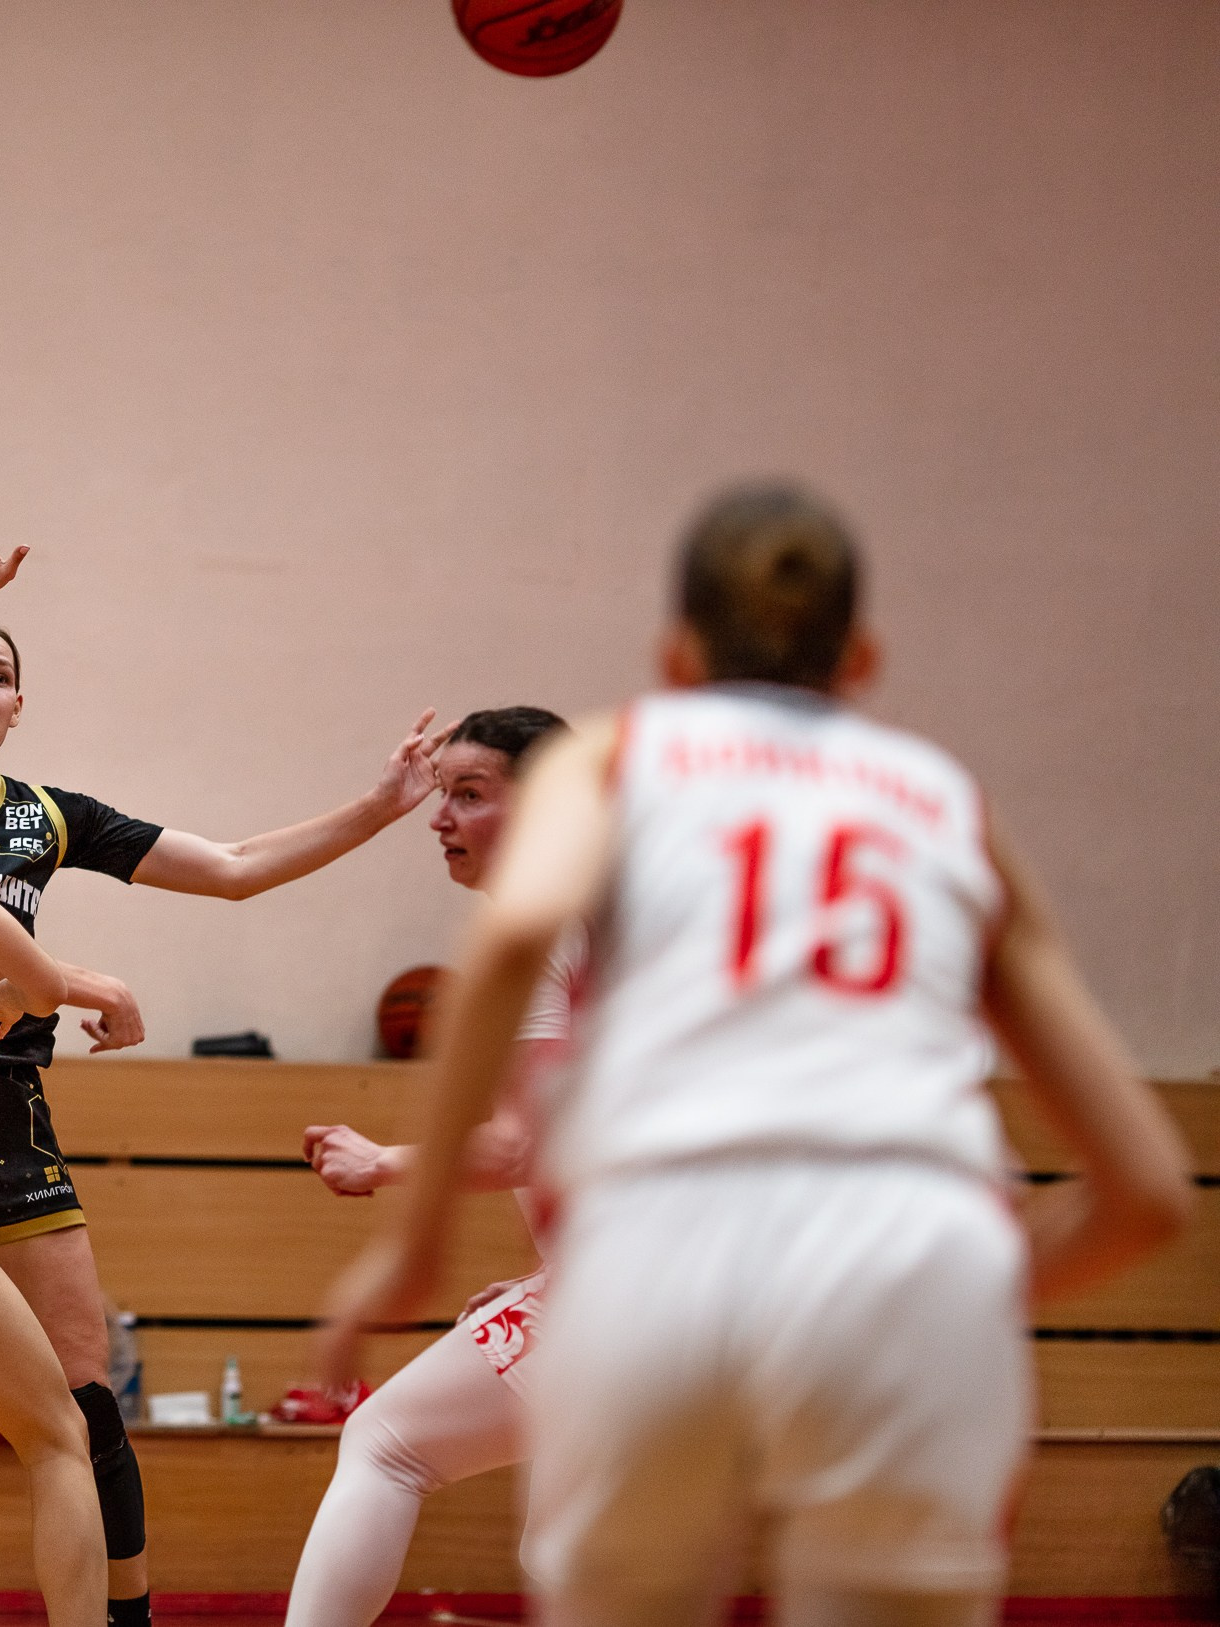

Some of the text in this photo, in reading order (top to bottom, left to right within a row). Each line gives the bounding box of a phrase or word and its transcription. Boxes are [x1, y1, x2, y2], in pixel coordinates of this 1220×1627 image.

[5, 803, 43, 818] FON
[5, 816, 43, 830] BET
[718, 813, 910, 1000] 15
